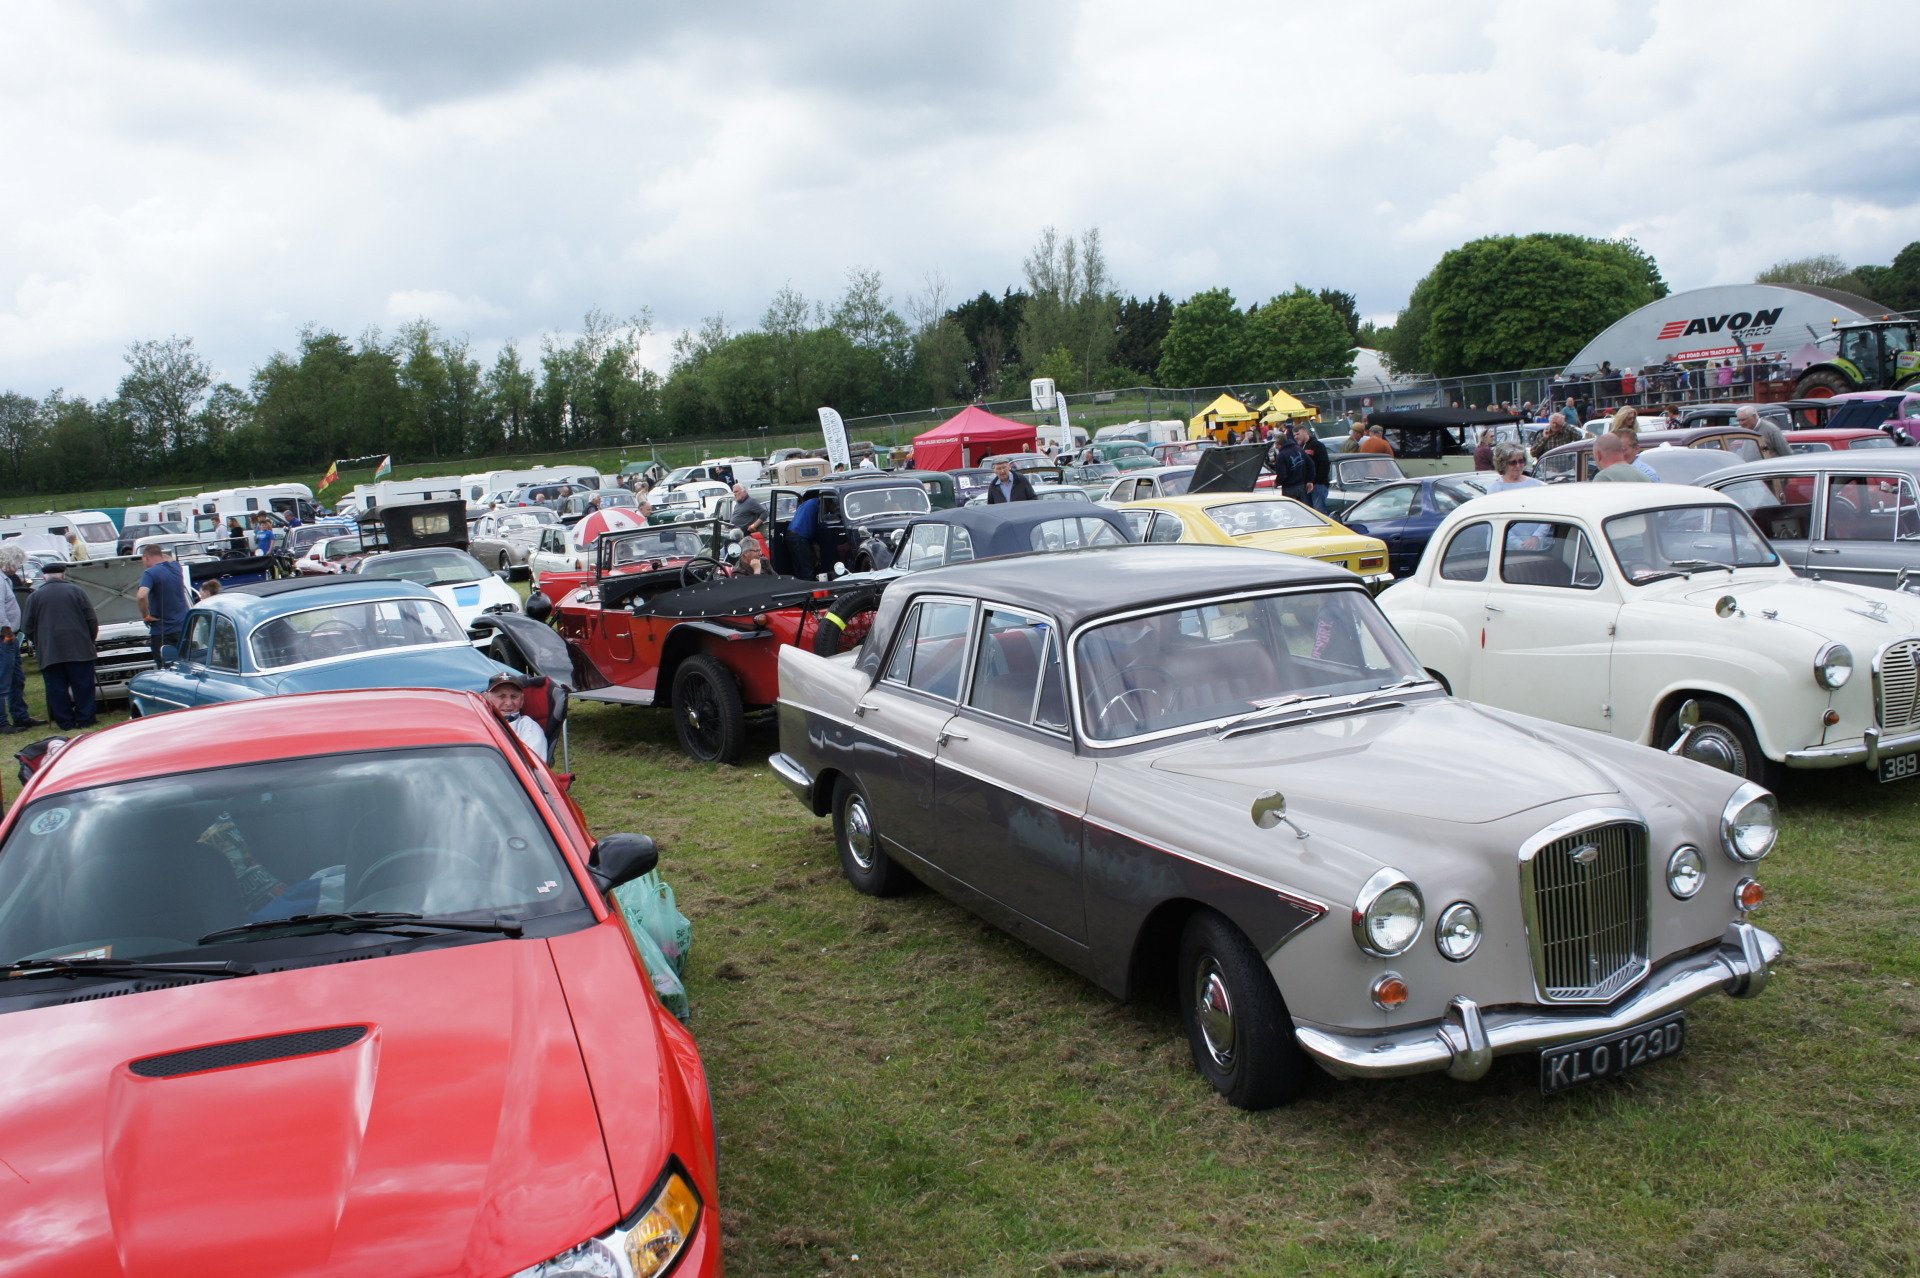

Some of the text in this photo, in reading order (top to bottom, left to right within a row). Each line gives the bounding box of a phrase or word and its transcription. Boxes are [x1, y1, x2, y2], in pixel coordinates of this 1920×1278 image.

[1683, 307, 1784, 336] AVON
[1731, 326, 1773, 338] TYRES
[1885, 753, 1917, 778] 389
[1551, 1022, 1681, 1088] KLO 123D
